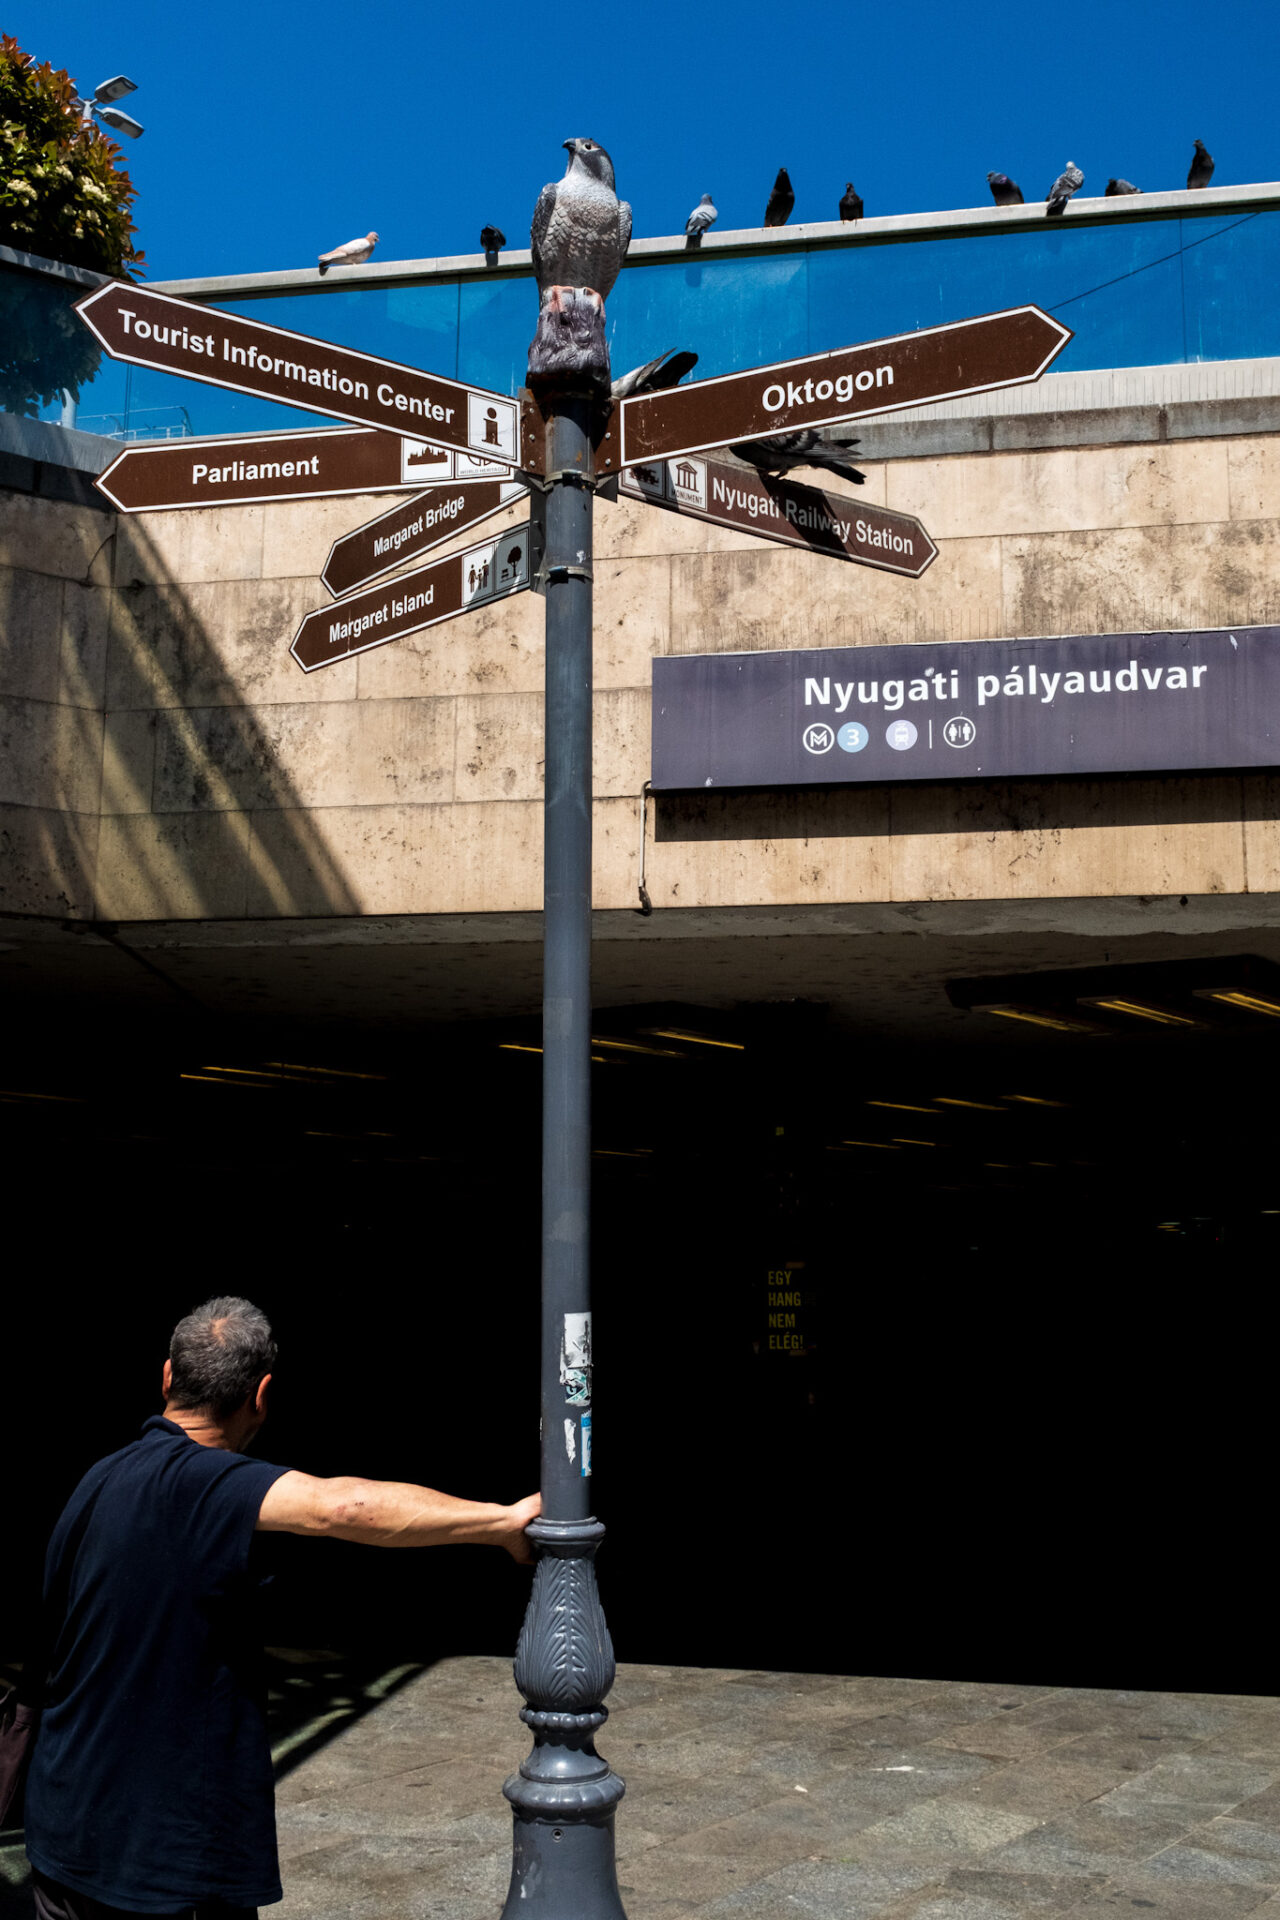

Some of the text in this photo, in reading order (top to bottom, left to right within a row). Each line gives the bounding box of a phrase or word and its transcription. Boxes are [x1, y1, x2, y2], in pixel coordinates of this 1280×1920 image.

[118, 308, 455, 424] Tourist Information Center
[761, 365, 895, 412] Oktogon
[192, 454, 320, 485] Parliament
[671, 488, 703, 504] MONUMENT
[373, 493, 465, 557] Margaret Bridge
[712, 476, 914, 556] Nyugati Railway Station
[329, 585, 435, 643] Margaret Island
[803, 660, 1208, 713] Nyugati pályaudvar
[846, 728, 861, 747] 3
[768, 1270, 792, 1286] EGY
[768, 1291, 802, 1307] HANG
[768, 1312, 796, 1329] NEM
[769, 1331, 804, 1350] ELÉG!
